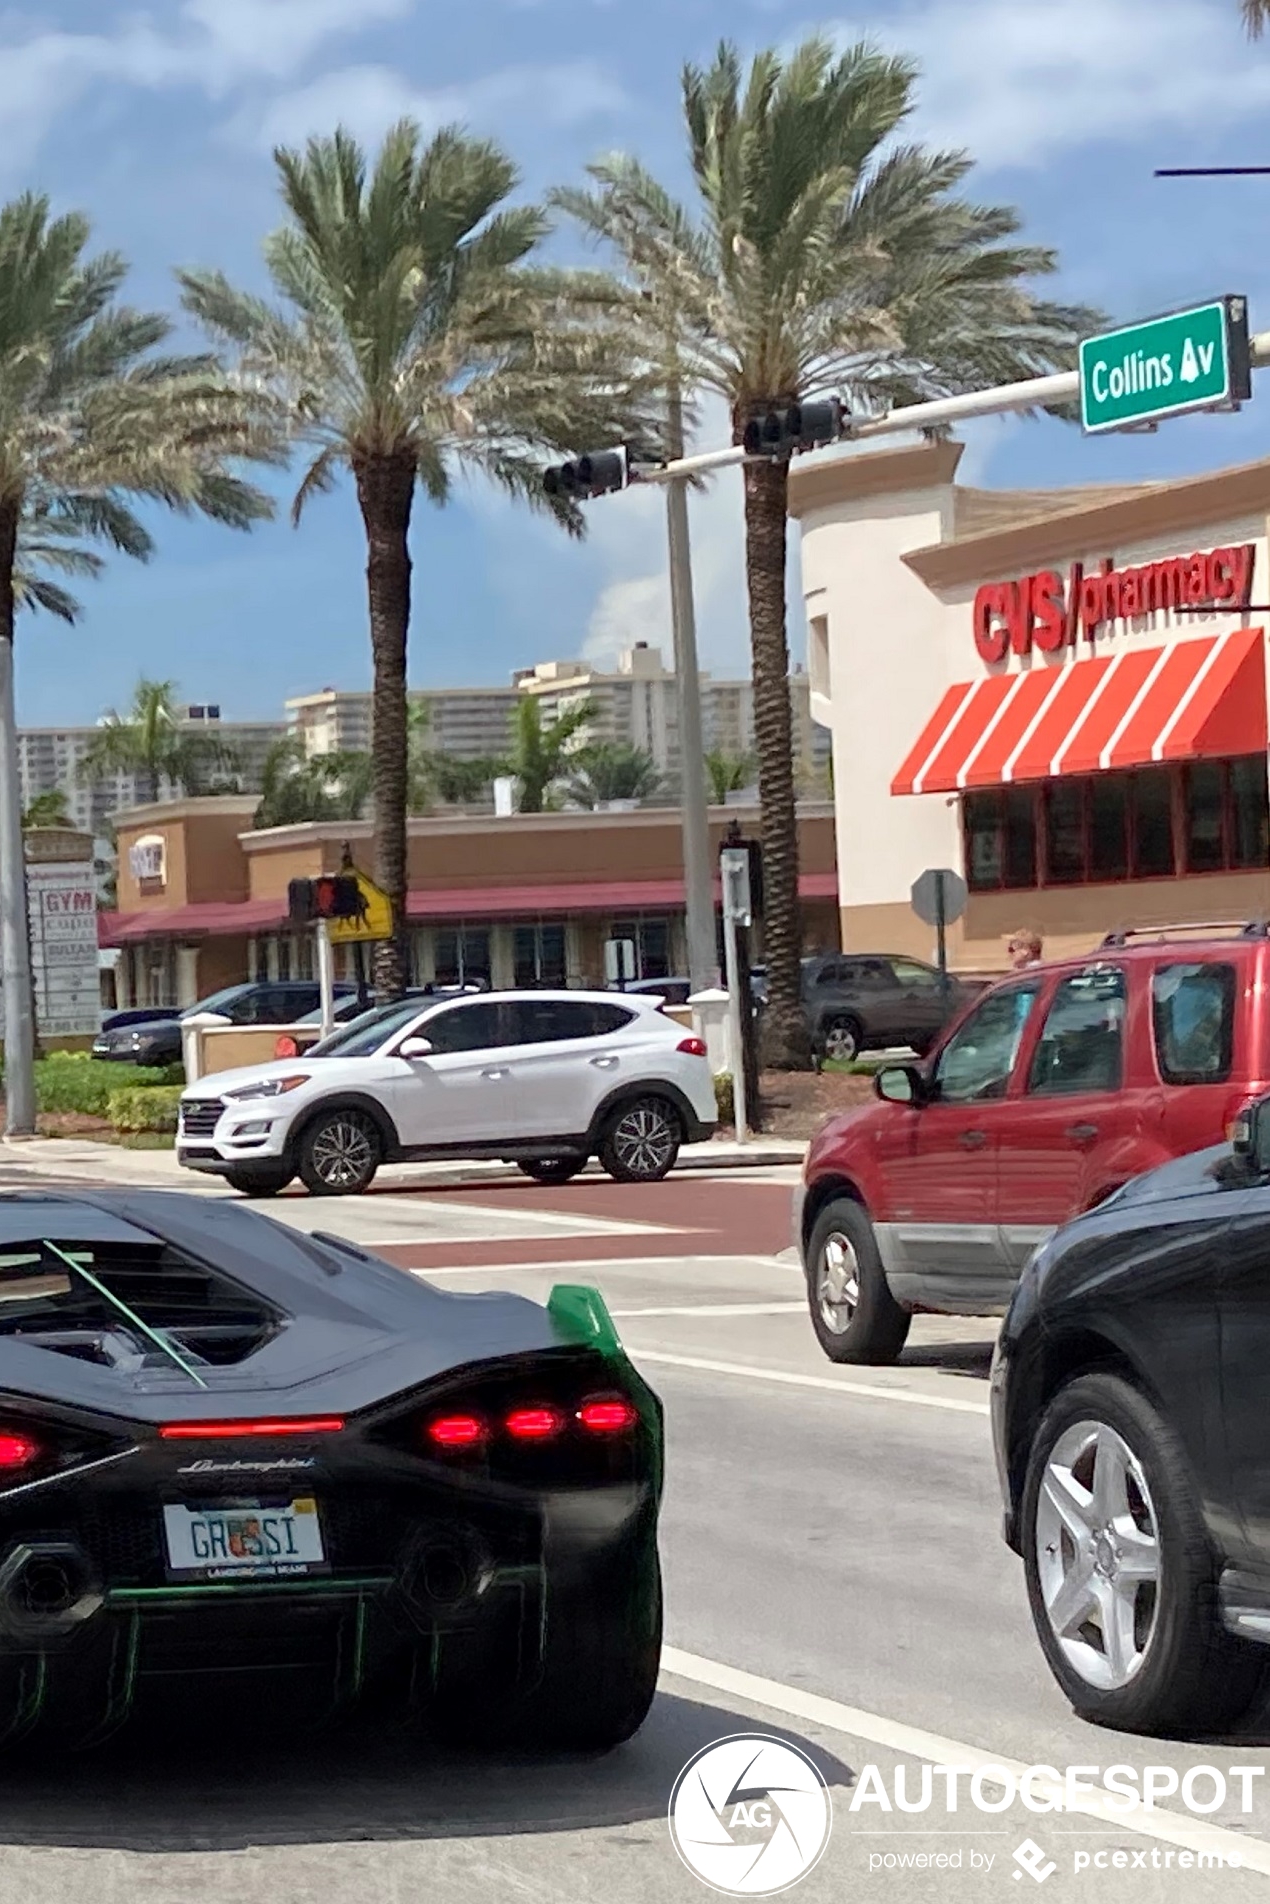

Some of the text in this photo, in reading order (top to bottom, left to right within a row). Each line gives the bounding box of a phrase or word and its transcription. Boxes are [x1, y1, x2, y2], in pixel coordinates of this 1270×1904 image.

[1092, 337, 1215, 403] Collins Av
[46, 892, 92, 912] GYM
